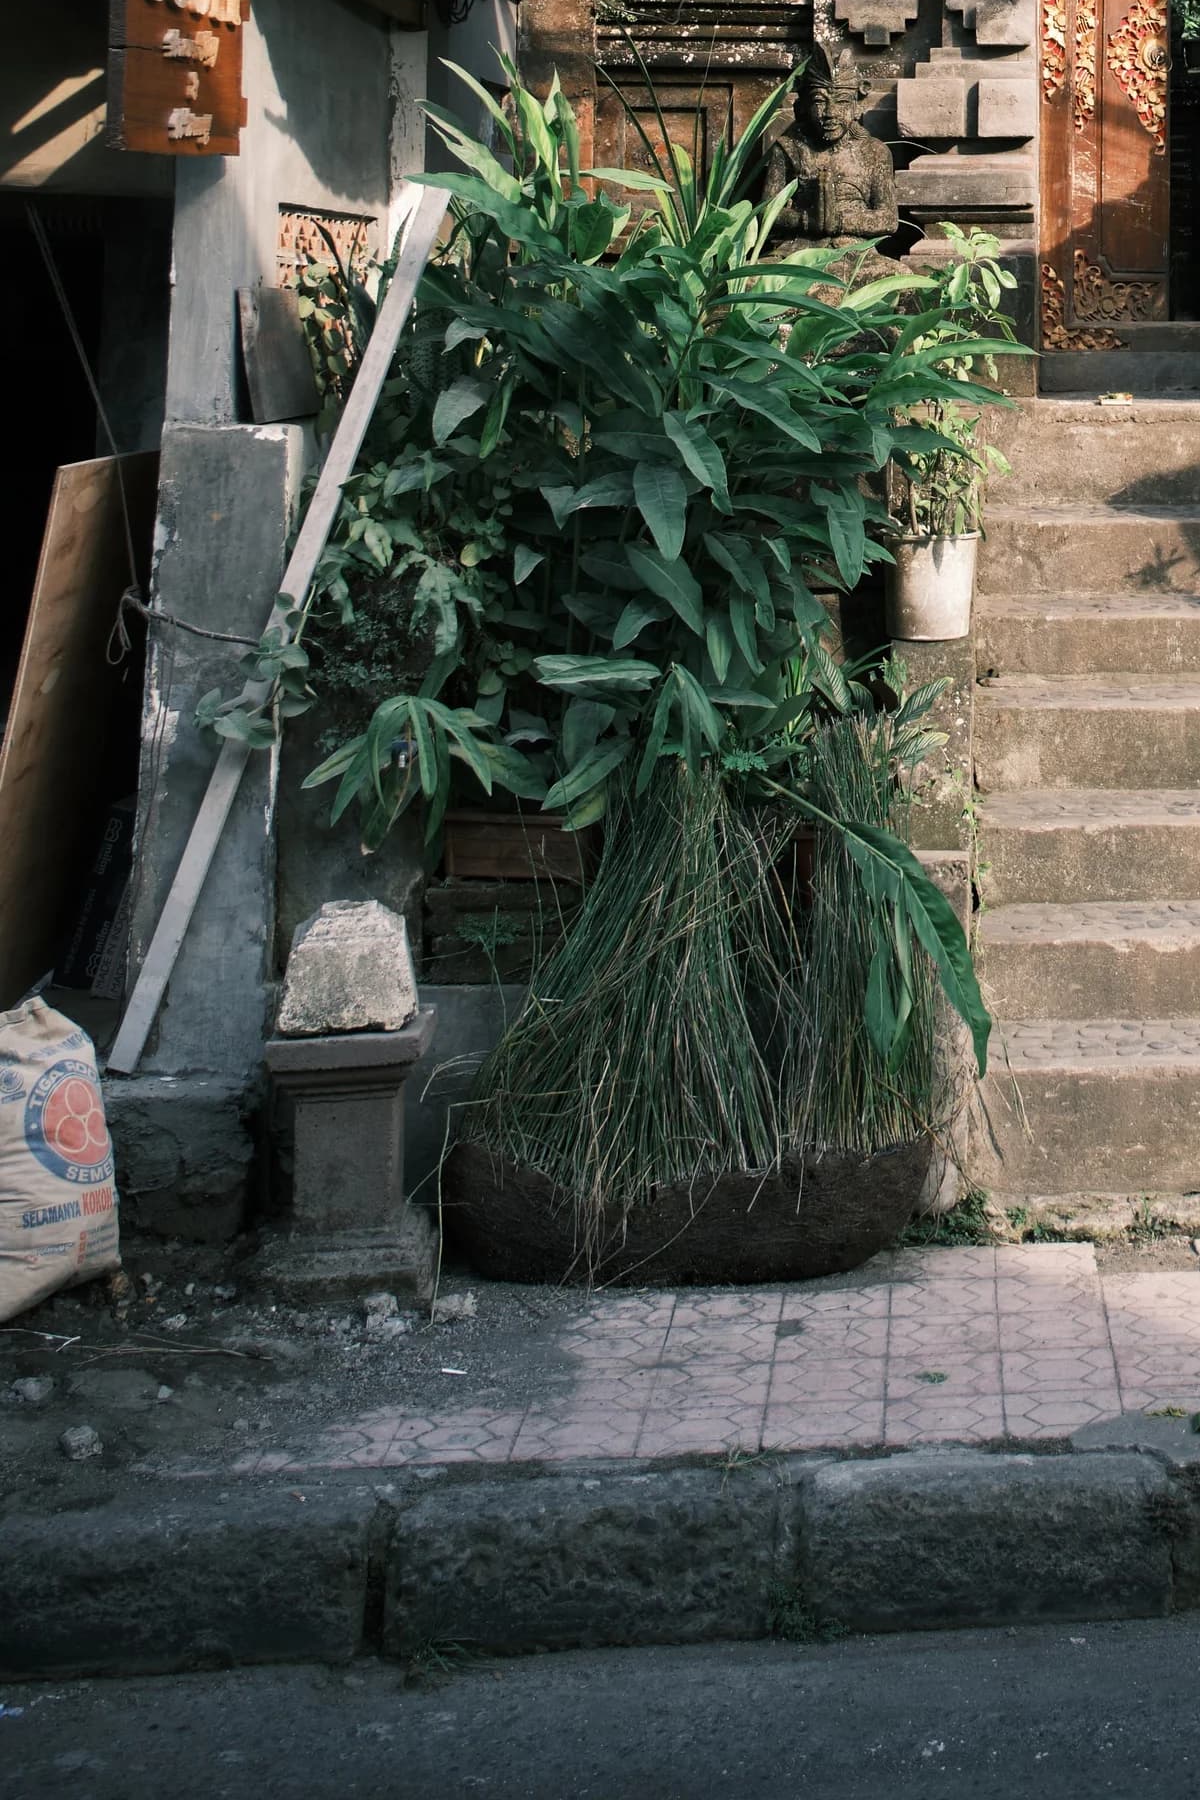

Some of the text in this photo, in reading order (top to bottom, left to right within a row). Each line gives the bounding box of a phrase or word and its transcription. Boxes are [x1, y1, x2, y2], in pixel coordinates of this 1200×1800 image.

[29, 1069, 65, 1109] TIGA
[66, 1160, 113, 1182] SEME
[22, 1199, 81, 1229] SELAMANYA
